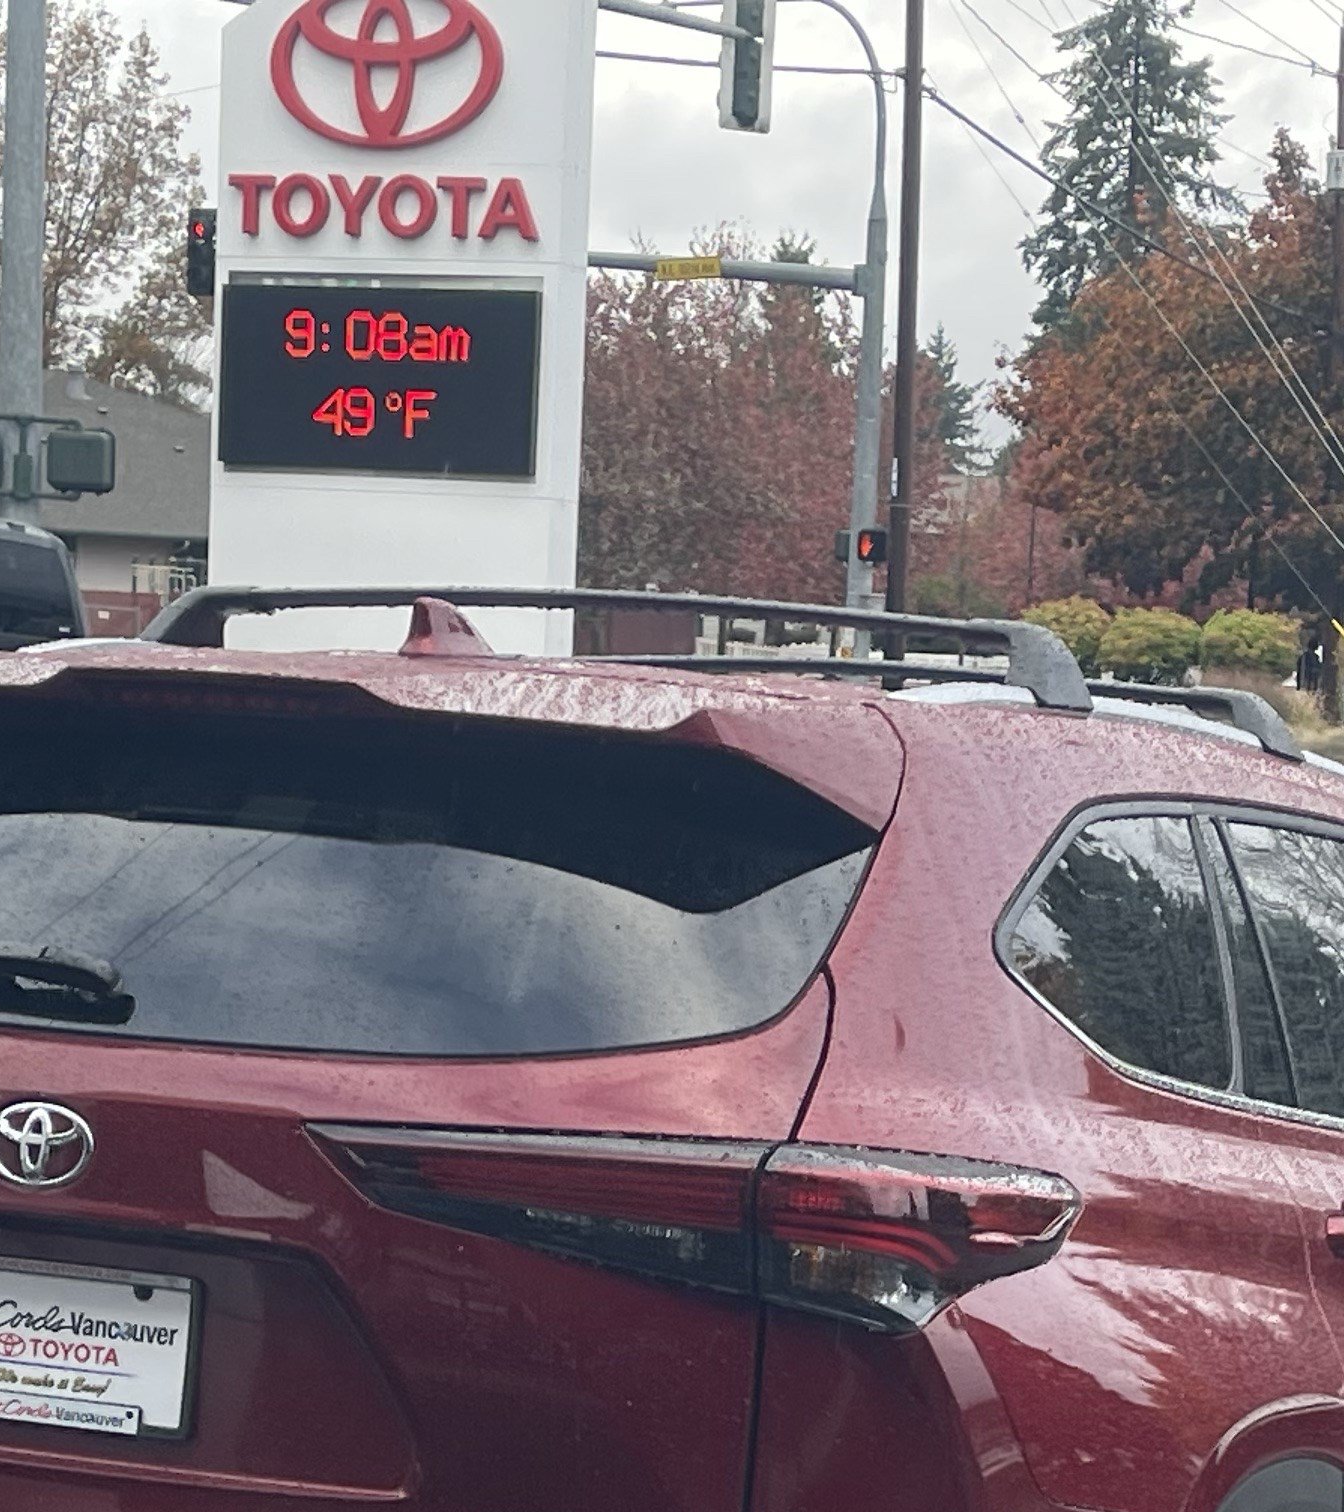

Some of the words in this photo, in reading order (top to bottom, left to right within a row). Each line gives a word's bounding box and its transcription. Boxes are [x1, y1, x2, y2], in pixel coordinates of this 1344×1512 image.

[229, 172, 540, 242] TOYOTA
[70, 1311, 179, 1346] Vancouver
[29, 1338, 119, 1367] TOYOTA
[55, 1406, 127, 1429] Vancouver
